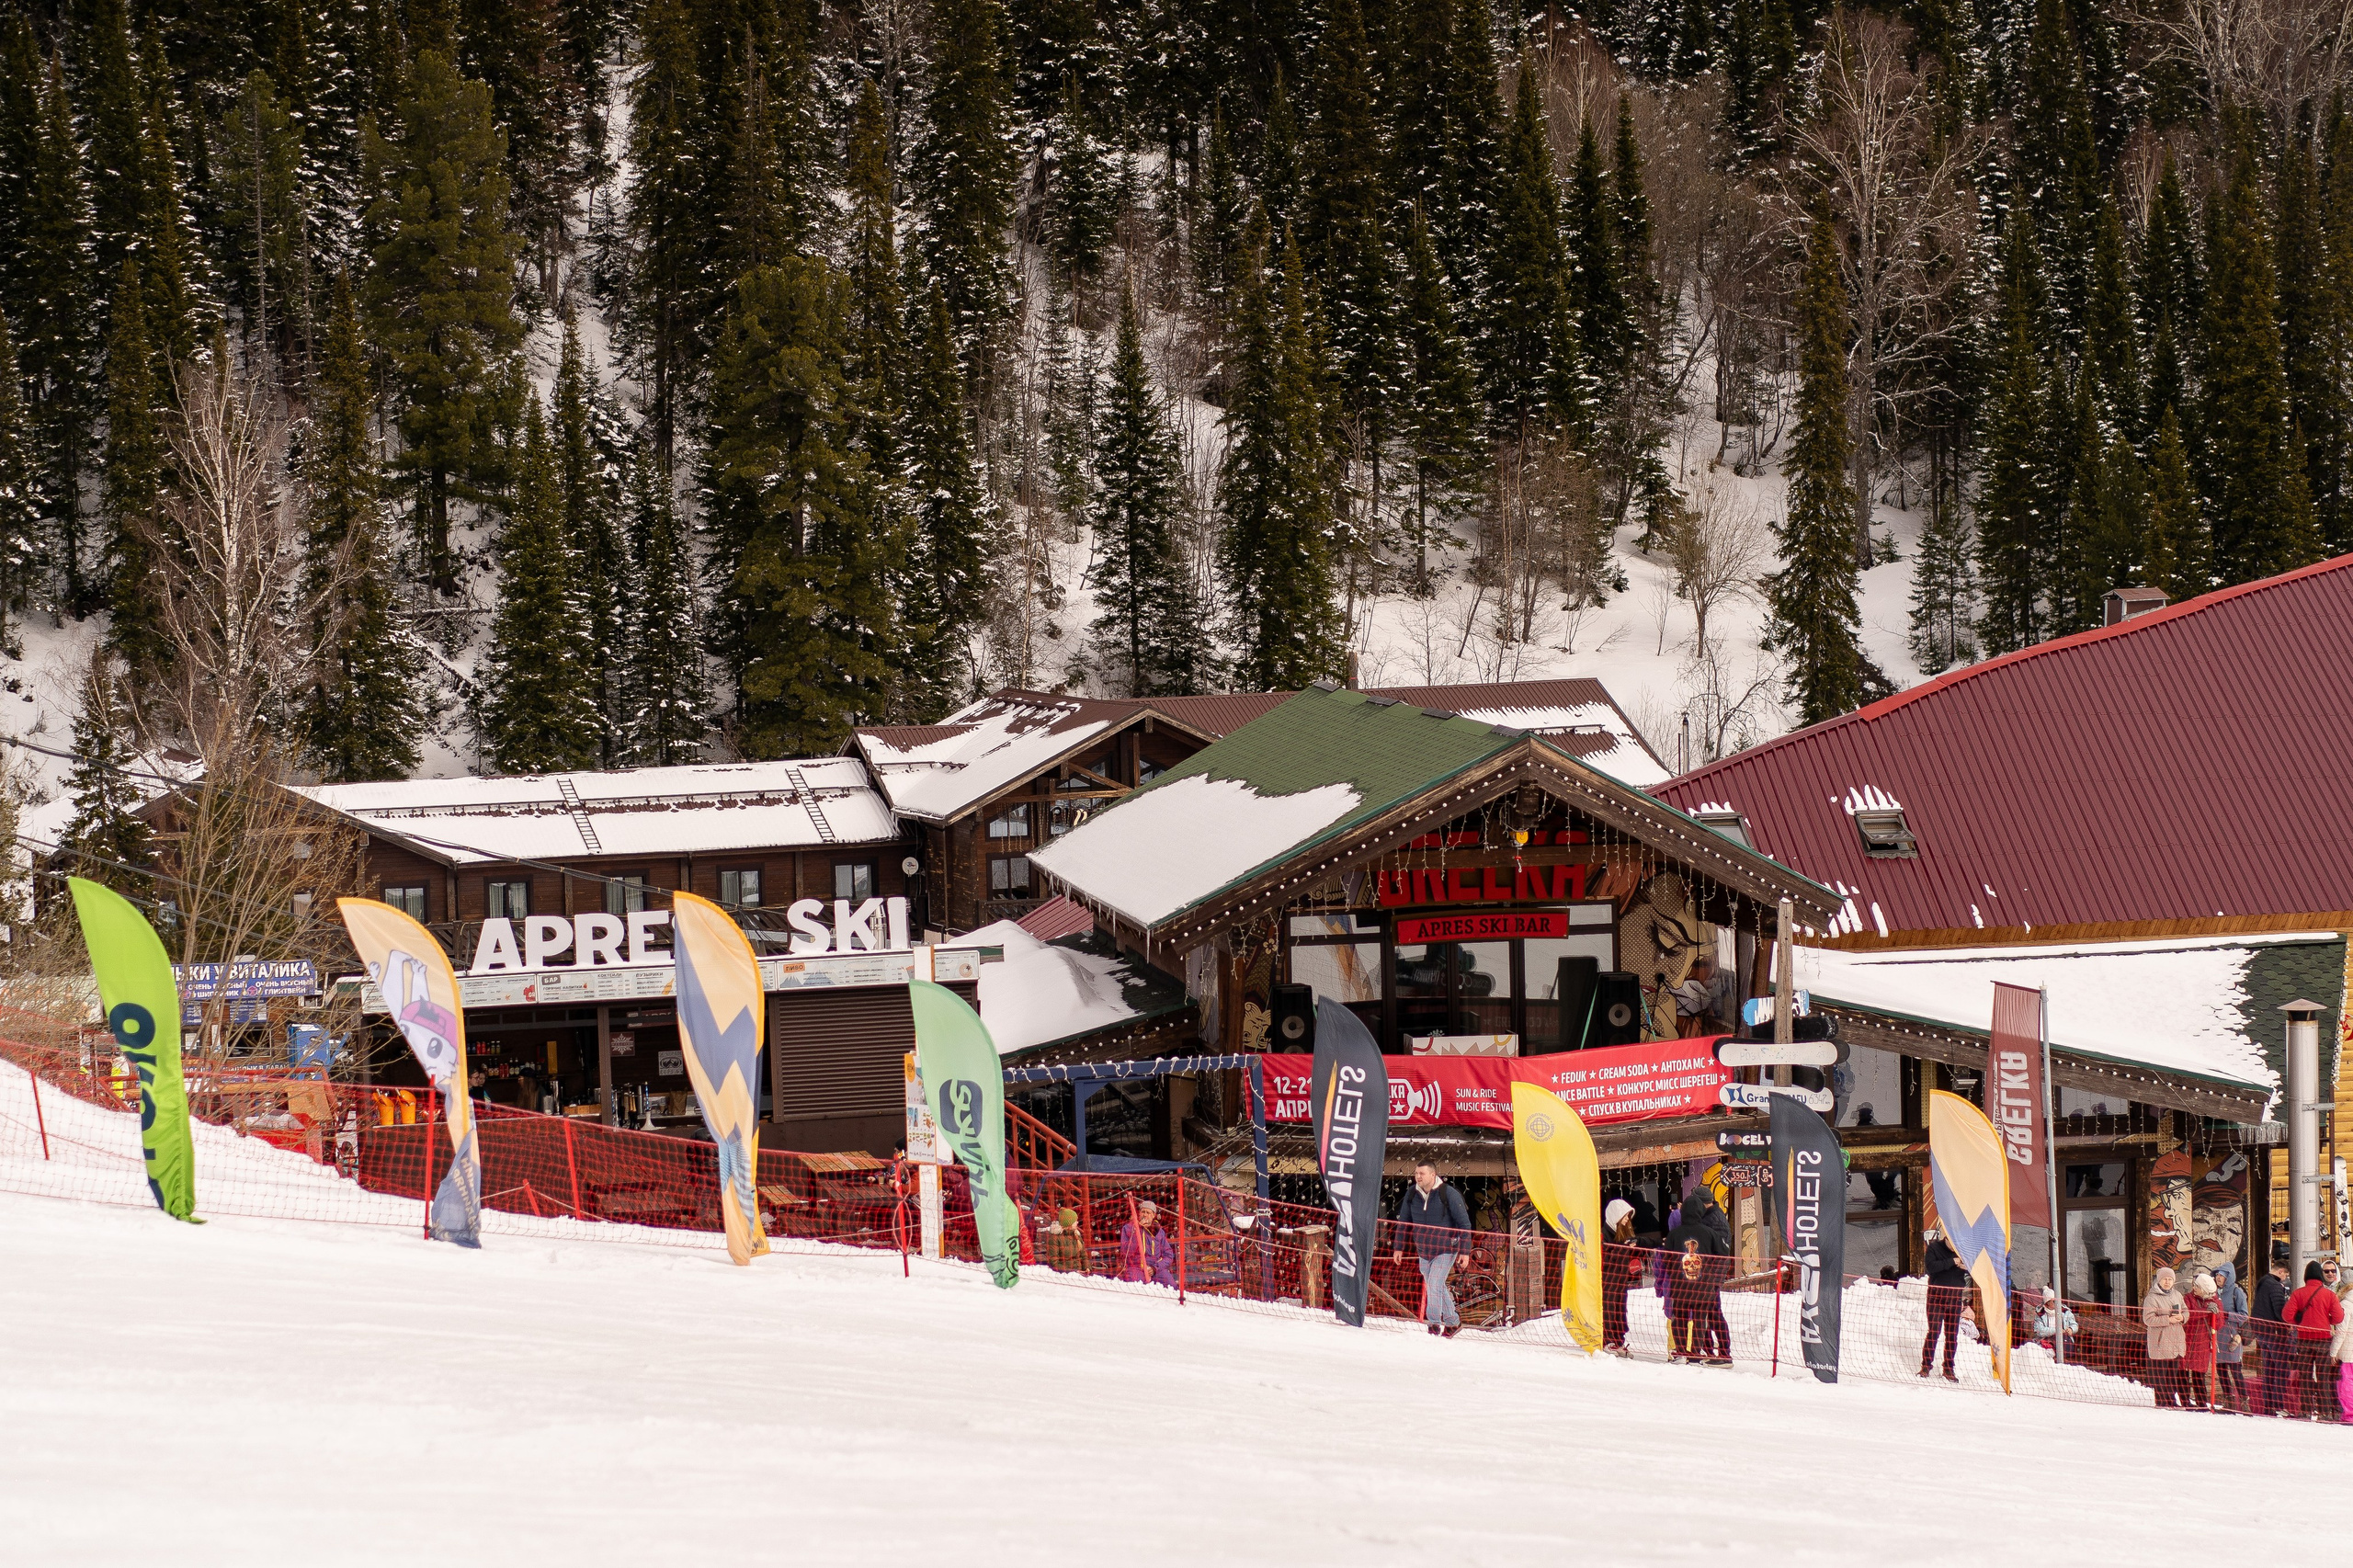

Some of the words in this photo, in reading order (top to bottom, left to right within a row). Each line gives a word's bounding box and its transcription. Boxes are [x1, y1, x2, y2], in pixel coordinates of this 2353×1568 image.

[472, 909, 676, 971] APRE
[787, 897, 908, 954] SKI
[1417, 918, 1477, 938] APRES
[1479, 916, 1510, 934] SKI
[1516, 916, 1552, 934] BAR
[1561, 1070, 1586, 1085] FEDUK
[1598, 1064, 1627, 1080] CREAM
[1627, 1063, 1649, 1077] SODA
[1660, 1058, 1693, 1074] АНТОХА
[1456, 1088, 1472, 1098] SUN
[1472, 1089, 1479, 1098] &
[1480, 1088, 1497, 1098] RIDE
[1576, 1085, 1605, 1099] BATTLE
[1617, 1080, 1654, 1096] КОНКУРС
[1655, 1077, 1679, 1092] МИСС
[1680, 1073, 1718, 1088] ШЕРЕГЕШ
[1456, 1102, 1480, 1111] MUSIC
[1588, 1104, 1615, 1118] СПУСК
[1616, 1103, 1622, 1114] В
[1622, 1094, 1682, 1114] КУПАЛЬНИКАХ
